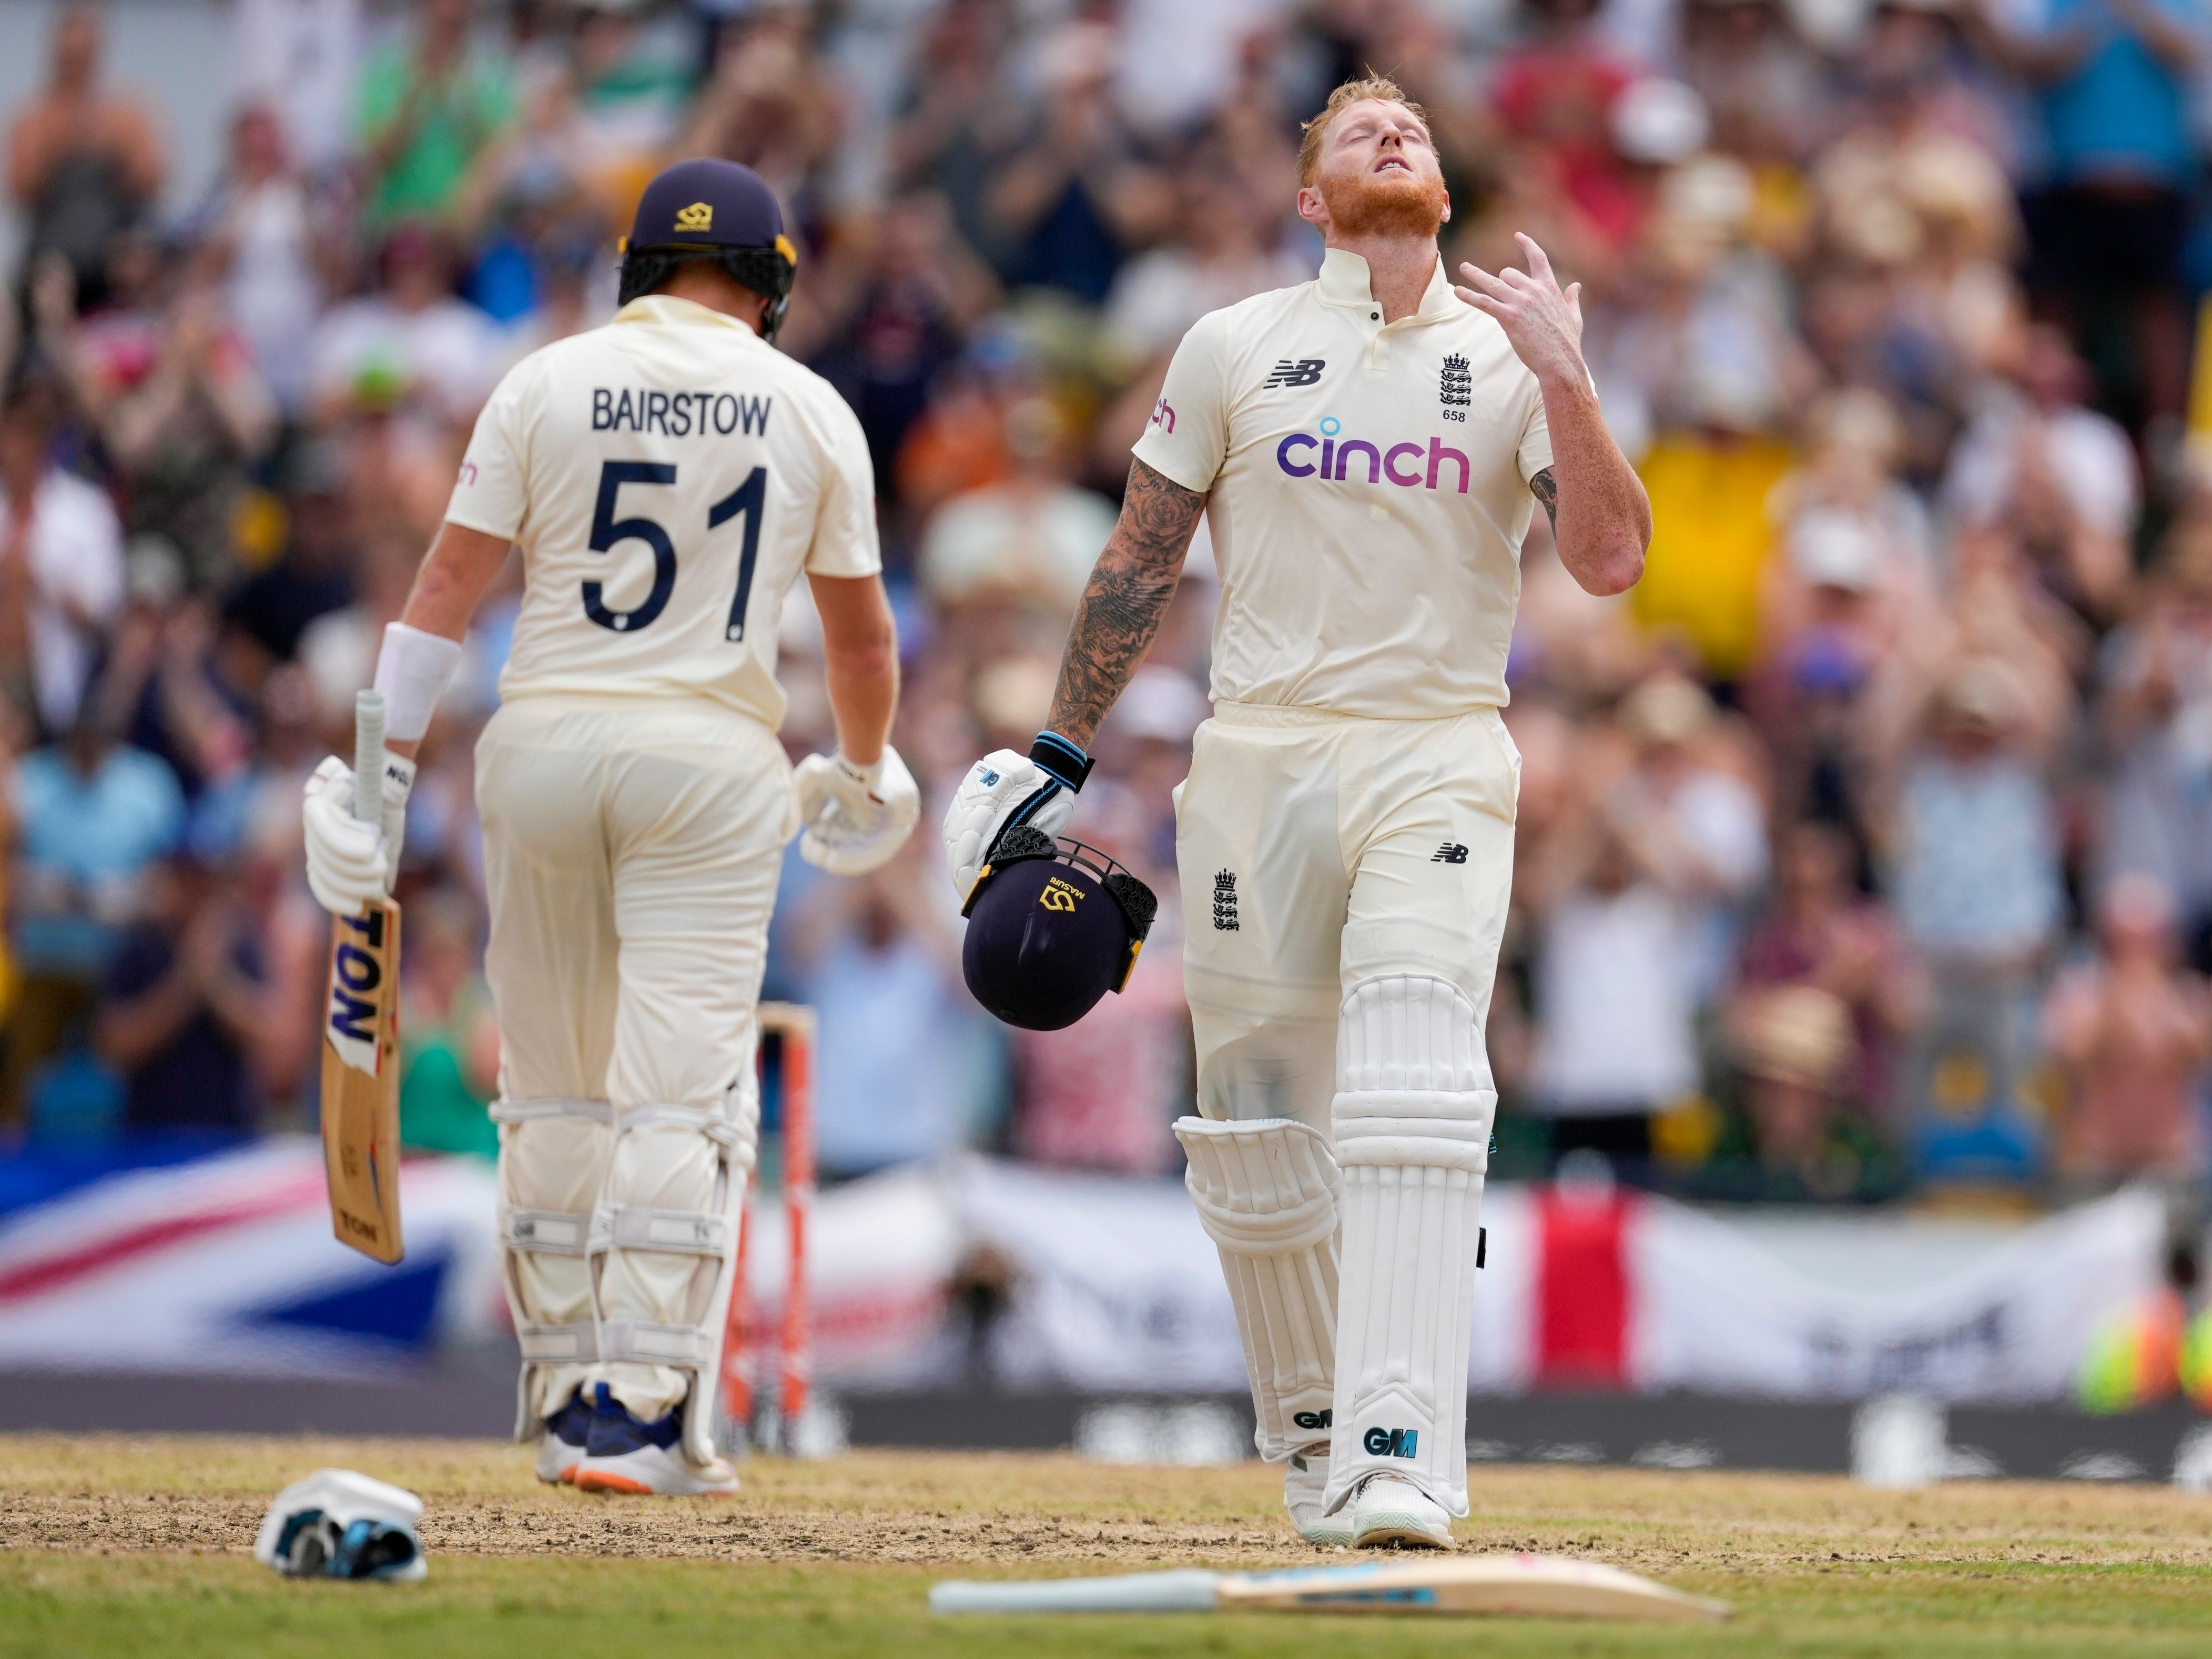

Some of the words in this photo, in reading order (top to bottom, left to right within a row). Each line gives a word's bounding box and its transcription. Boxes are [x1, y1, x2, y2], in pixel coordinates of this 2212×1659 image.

[592, 389, 772, 437] BAIRSTOW
[1443, 409, 1465, 422] 658
[1277, 417, 1470, 493] cinch
[582, 459, 767, 642] 51
[1050, 876, 1085, 900] MASURI
[331, 908, 383, 1043] TON
[1363, 1427, 1418, 1459] GM
